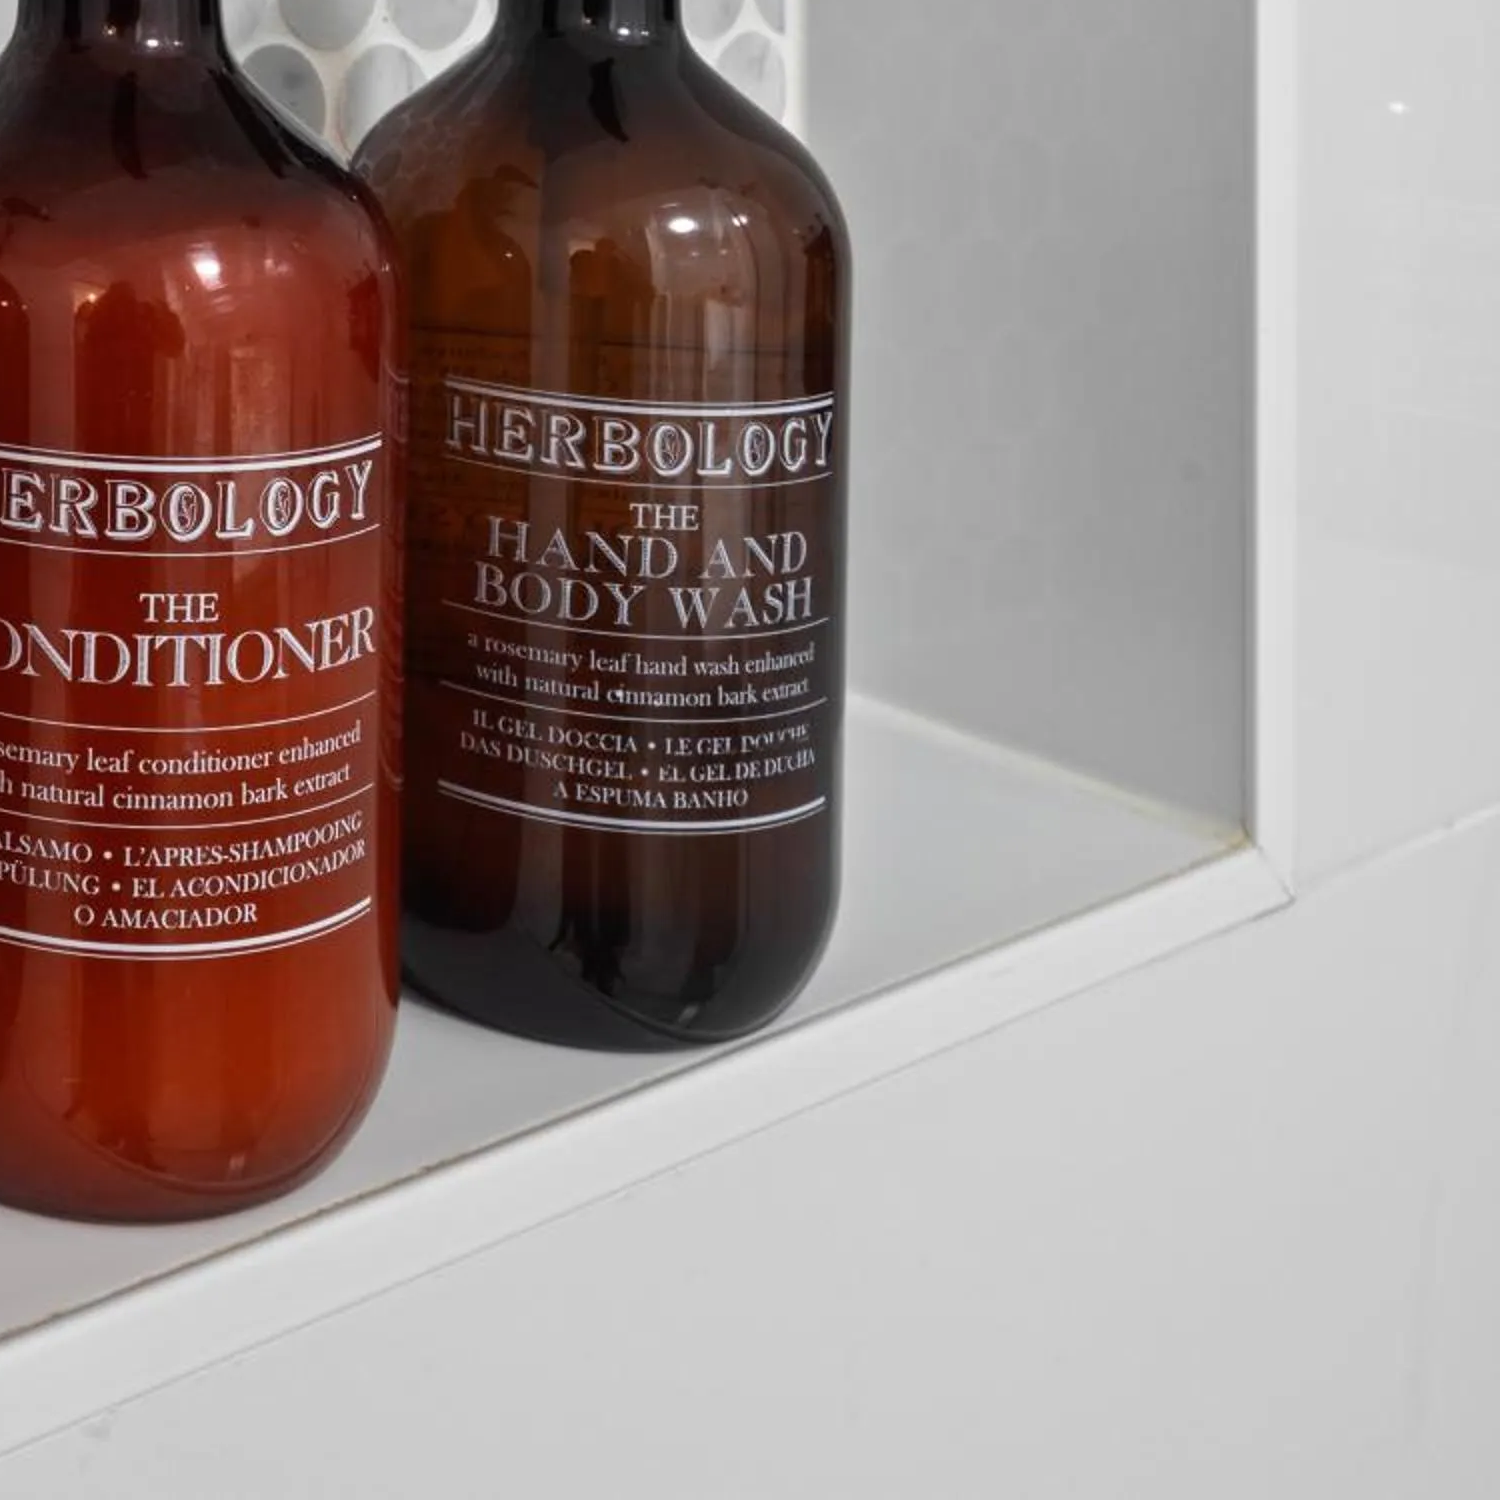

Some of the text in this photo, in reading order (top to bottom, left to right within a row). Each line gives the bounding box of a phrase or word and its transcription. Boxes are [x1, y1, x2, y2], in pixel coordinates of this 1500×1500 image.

[445, 393, 833, 477] HERBOLOGY
[629, 503, 699, 531] THE
[488, 515, 807, 579] HAND AND
[139, 592, 218, 623] THE
[475, 560, 812, 629] BODY WASH
[467, 633, 815, 676] a rosemary leaf hand wash enhanced
[476, 662, 808, 707] with natural cinnamon bark extract
[86, 748, 135, 773] leaf
[138, 746, 273, 774] conditioner
[279, 720, 361, 763] enhanced
[473, 709, 637, 753] IL GEL DOCCIA
[460, 731, 633, 780] DAS DUSCHGEL
[659, 764, 686, 782] EL
[689, 763, 731, 782] GEL
[735, 759, 761, 780] DE
[21, 778, 104, 808] natural
[113, 786, 233, 810] cinnamon
[240, 776, 288, 805] bark
[293, 763, 351, 797] extract
[553, 780, 749, 808] A ESPUMA BANHO
[132, 878, 163, 897] EL
[170, 839, 365, 897] ACONDICIONADOR
[75, 904, 257, 929] O AMACIADOR
